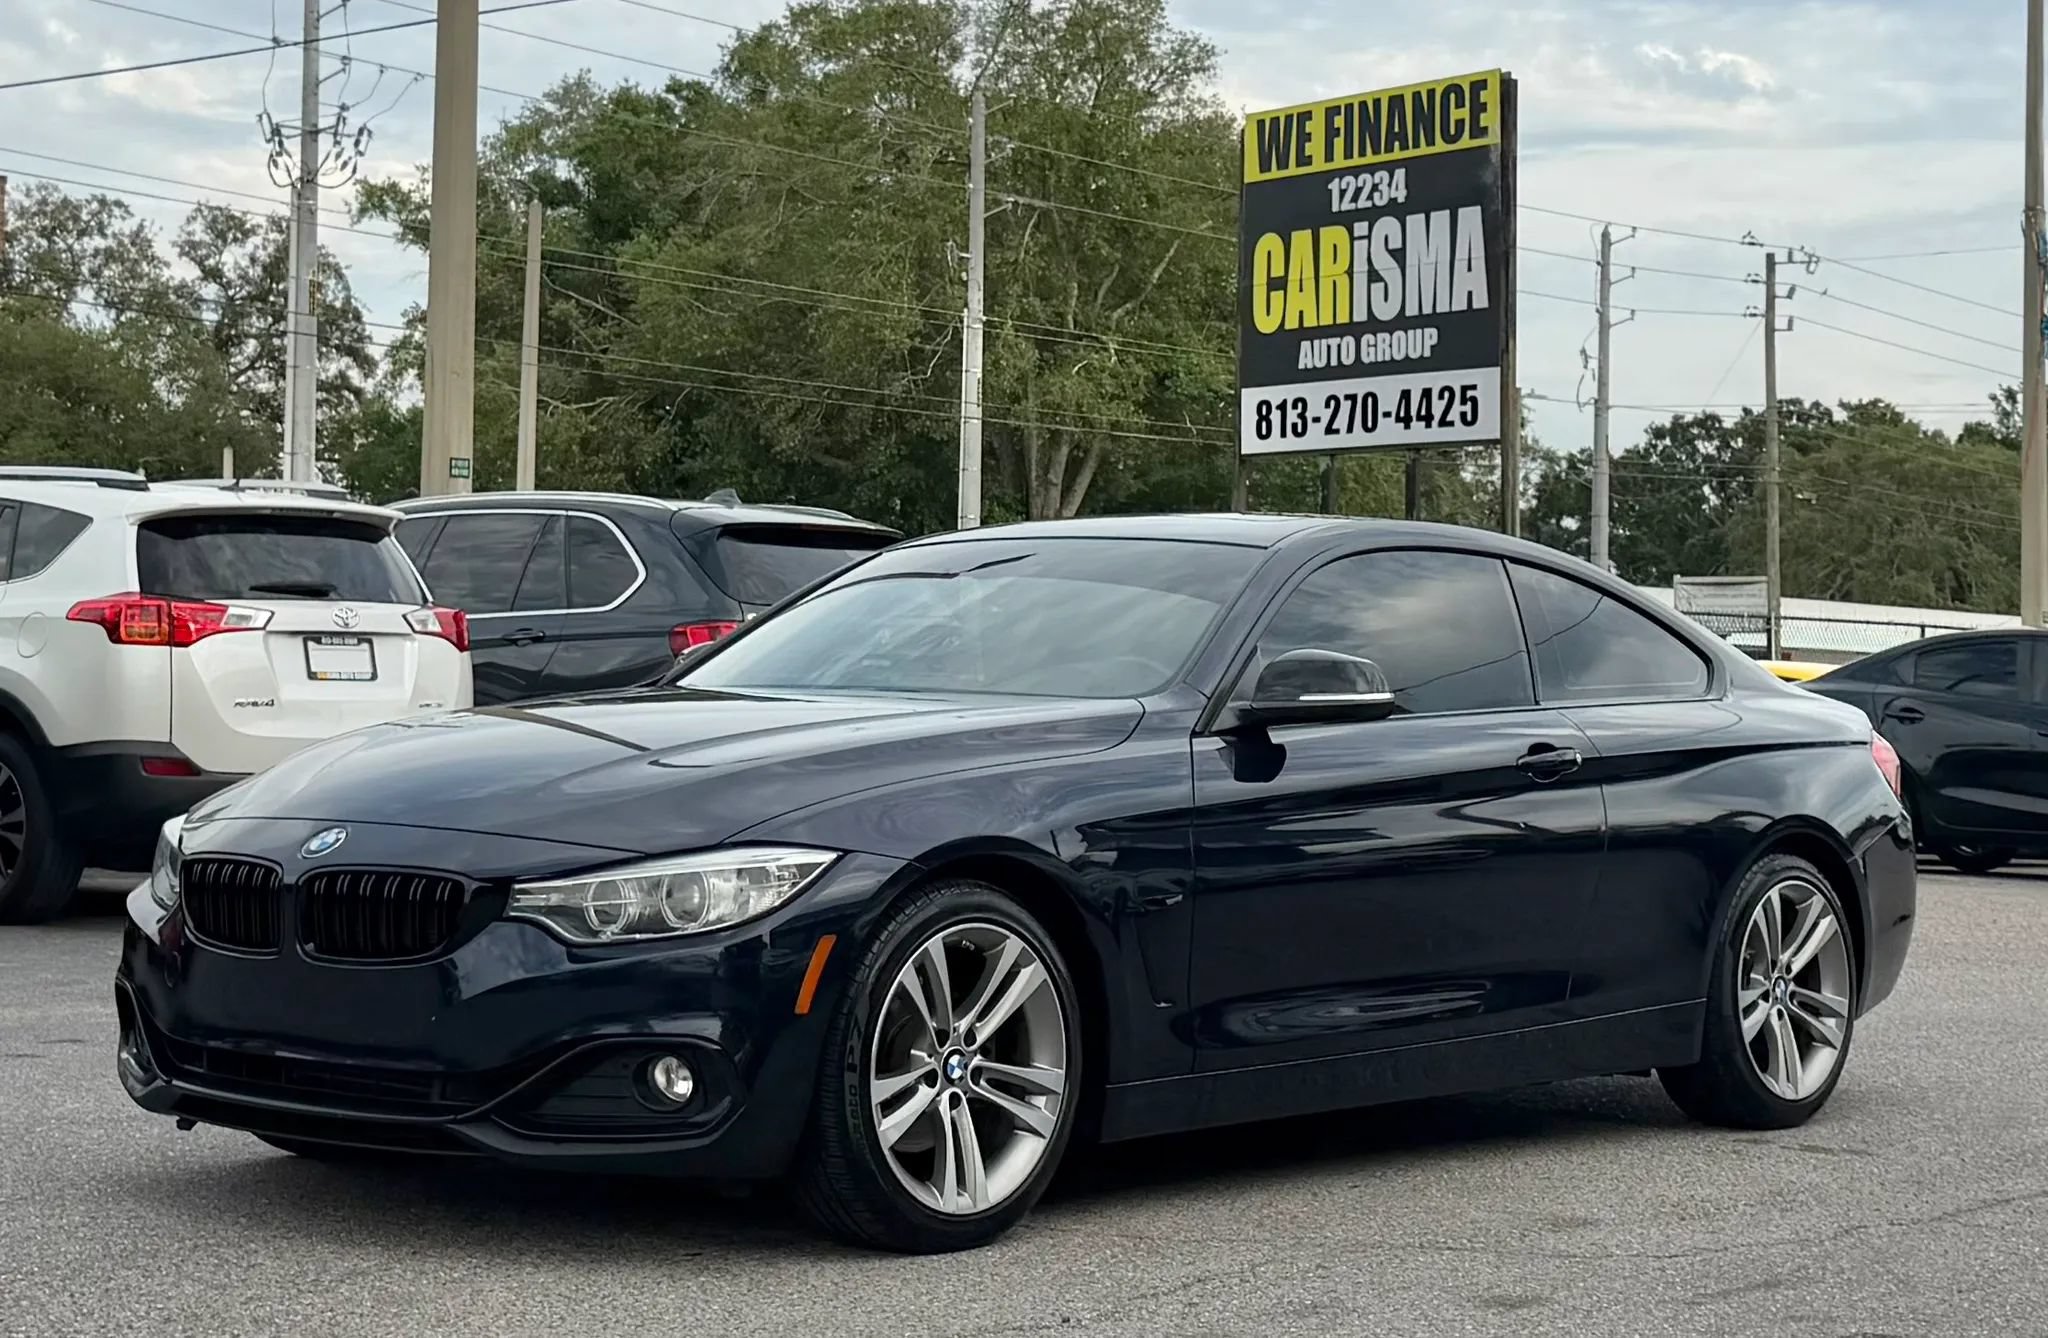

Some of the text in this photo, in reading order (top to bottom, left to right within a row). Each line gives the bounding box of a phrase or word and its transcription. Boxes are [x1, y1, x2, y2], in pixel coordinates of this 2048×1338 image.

[1256, 79, 1489, 174] WE FINANCE
[1328, 168, 1407, 212] 12234
[1252, 205, 1489, 334] CARiSMA
[1298, 328, 1439, 369] AUTO GROUP
[1255, 384, 1479, 440] 813-270-4425
